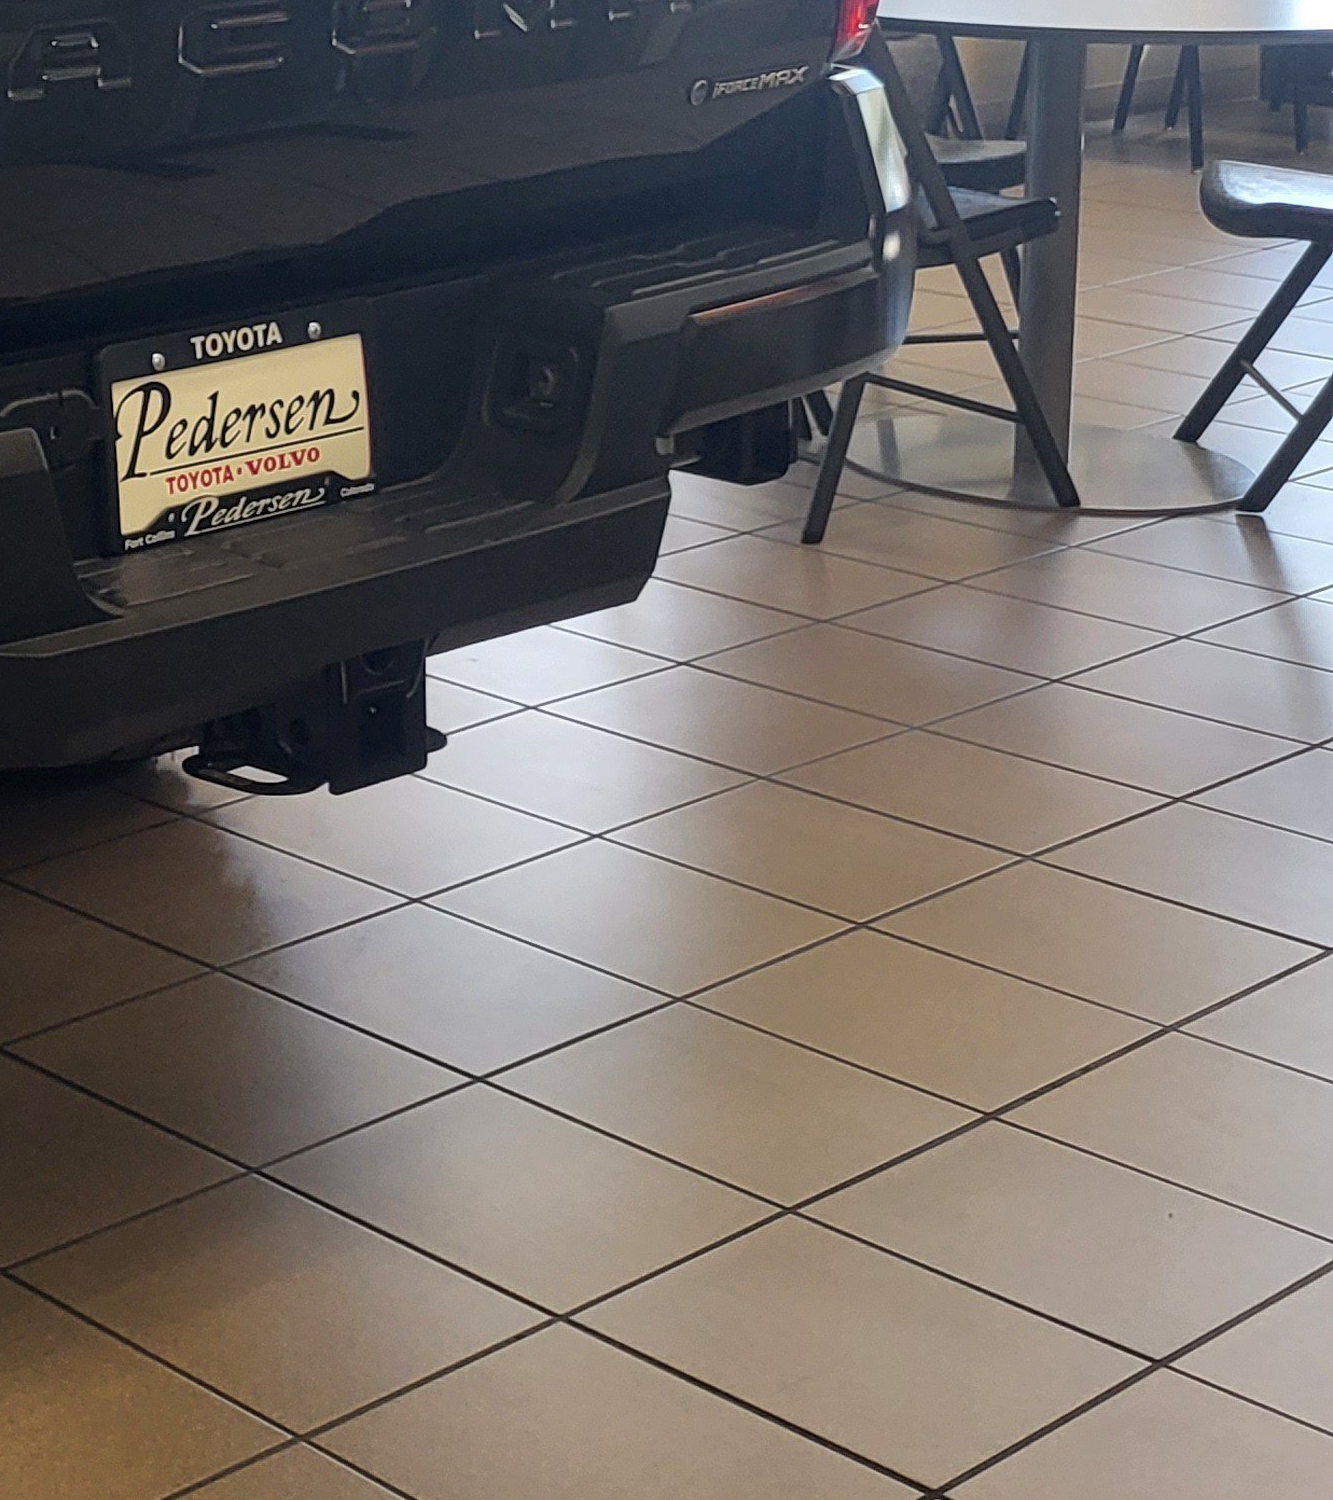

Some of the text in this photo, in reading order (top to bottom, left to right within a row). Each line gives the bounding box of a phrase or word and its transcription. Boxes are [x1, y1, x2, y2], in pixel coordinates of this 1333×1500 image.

[190, 322, 283, 359] TOYOTA
[115, 381, 361, 482] Pedersen
[165, 447, 321, 495] TOYOTA VOLVO
[181, 487, 326, 537] Pedersen
